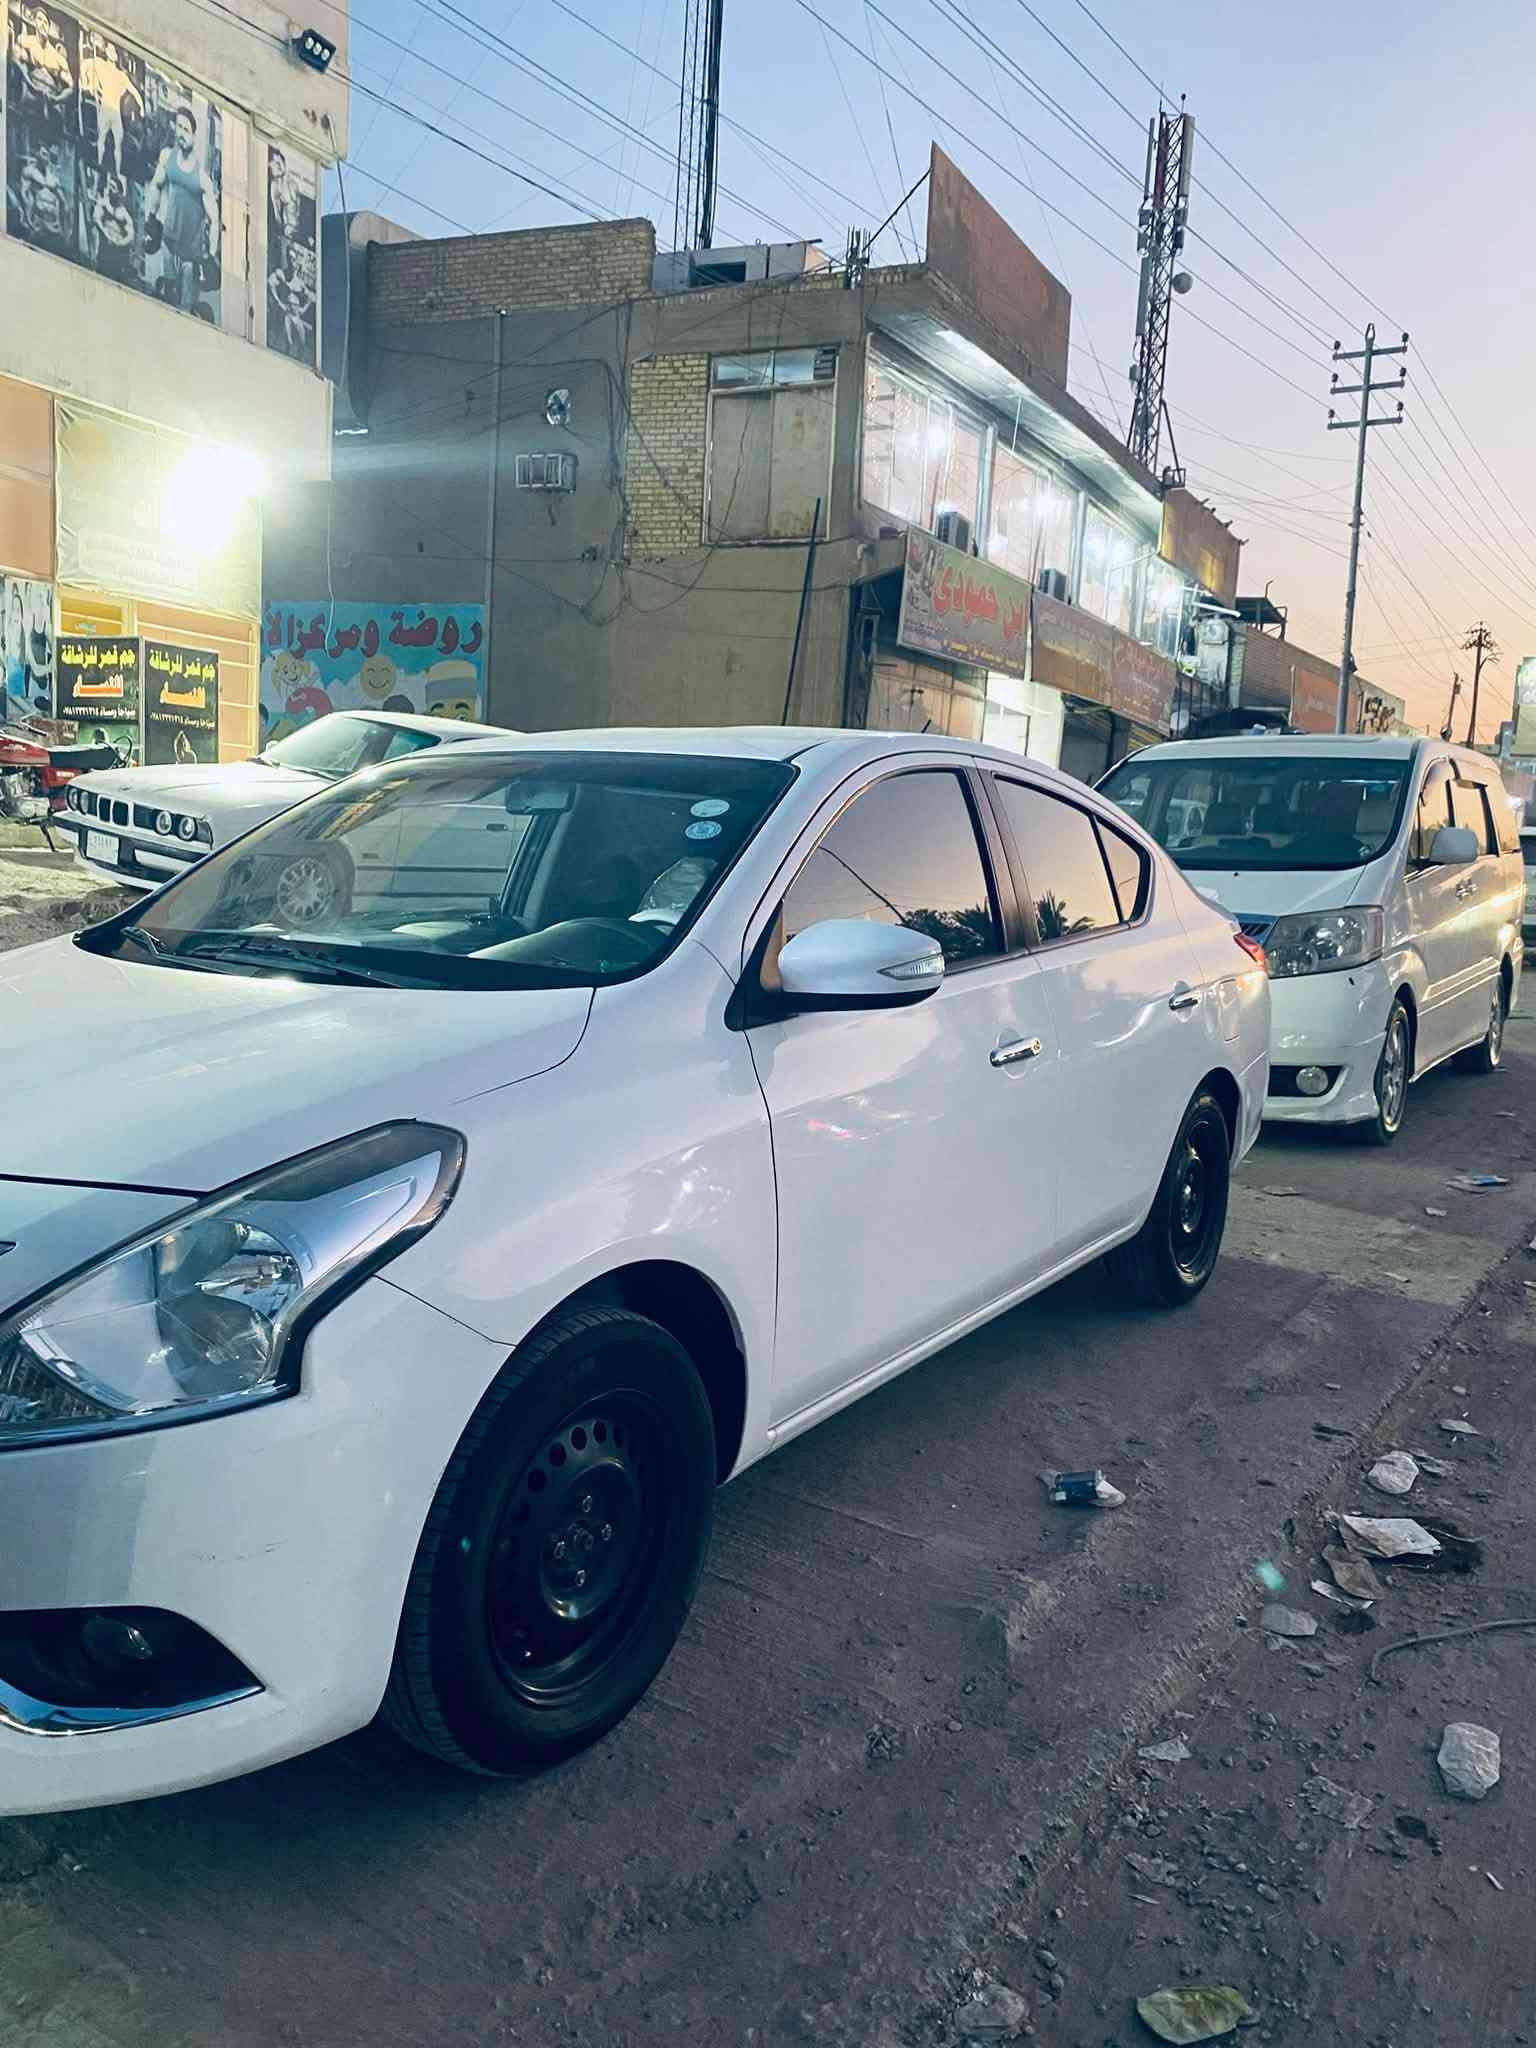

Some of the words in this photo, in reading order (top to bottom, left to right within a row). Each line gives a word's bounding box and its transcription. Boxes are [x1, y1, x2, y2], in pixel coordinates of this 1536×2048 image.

[290, 612, 380, 658] ومركز
[389, 609, 483, 655] روضة
[61, 645, 97, 669] للرشاقة
[149, 649, 183, 677] للرشاقة
